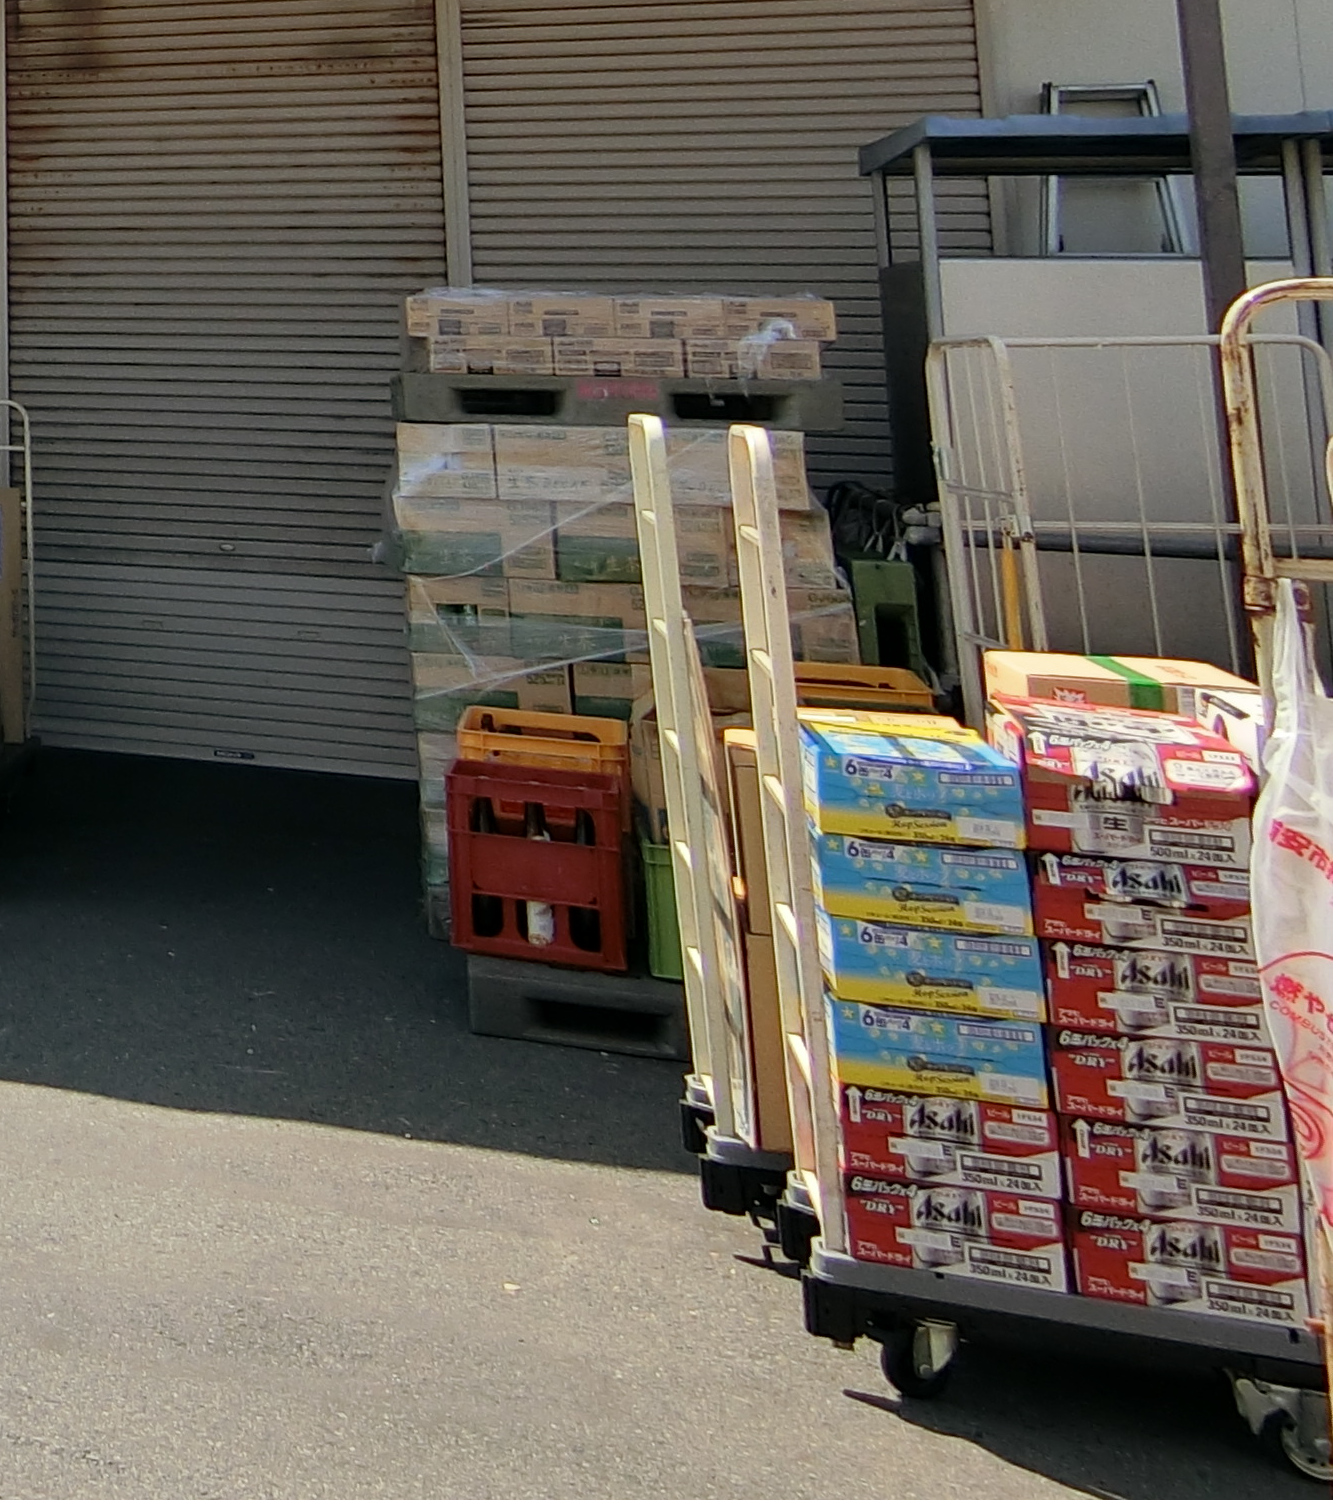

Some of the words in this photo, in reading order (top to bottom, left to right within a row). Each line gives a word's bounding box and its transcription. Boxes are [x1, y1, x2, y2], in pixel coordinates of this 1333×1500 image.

[1103, 816, 1130, 832] 生
[1112, 868, 1182, 894] Asahi
[1120, 958, 1190, 990] Asahi
[1127, 1046, 1197, 1079] Asahi
[910, 1104, 975, 1136] Asahi
[1142, 1138, 1211, 1170] Asahi
[916, 1196, 982, 1227] Asahi
[1150, 1231, 1220, 1264] Asahi
